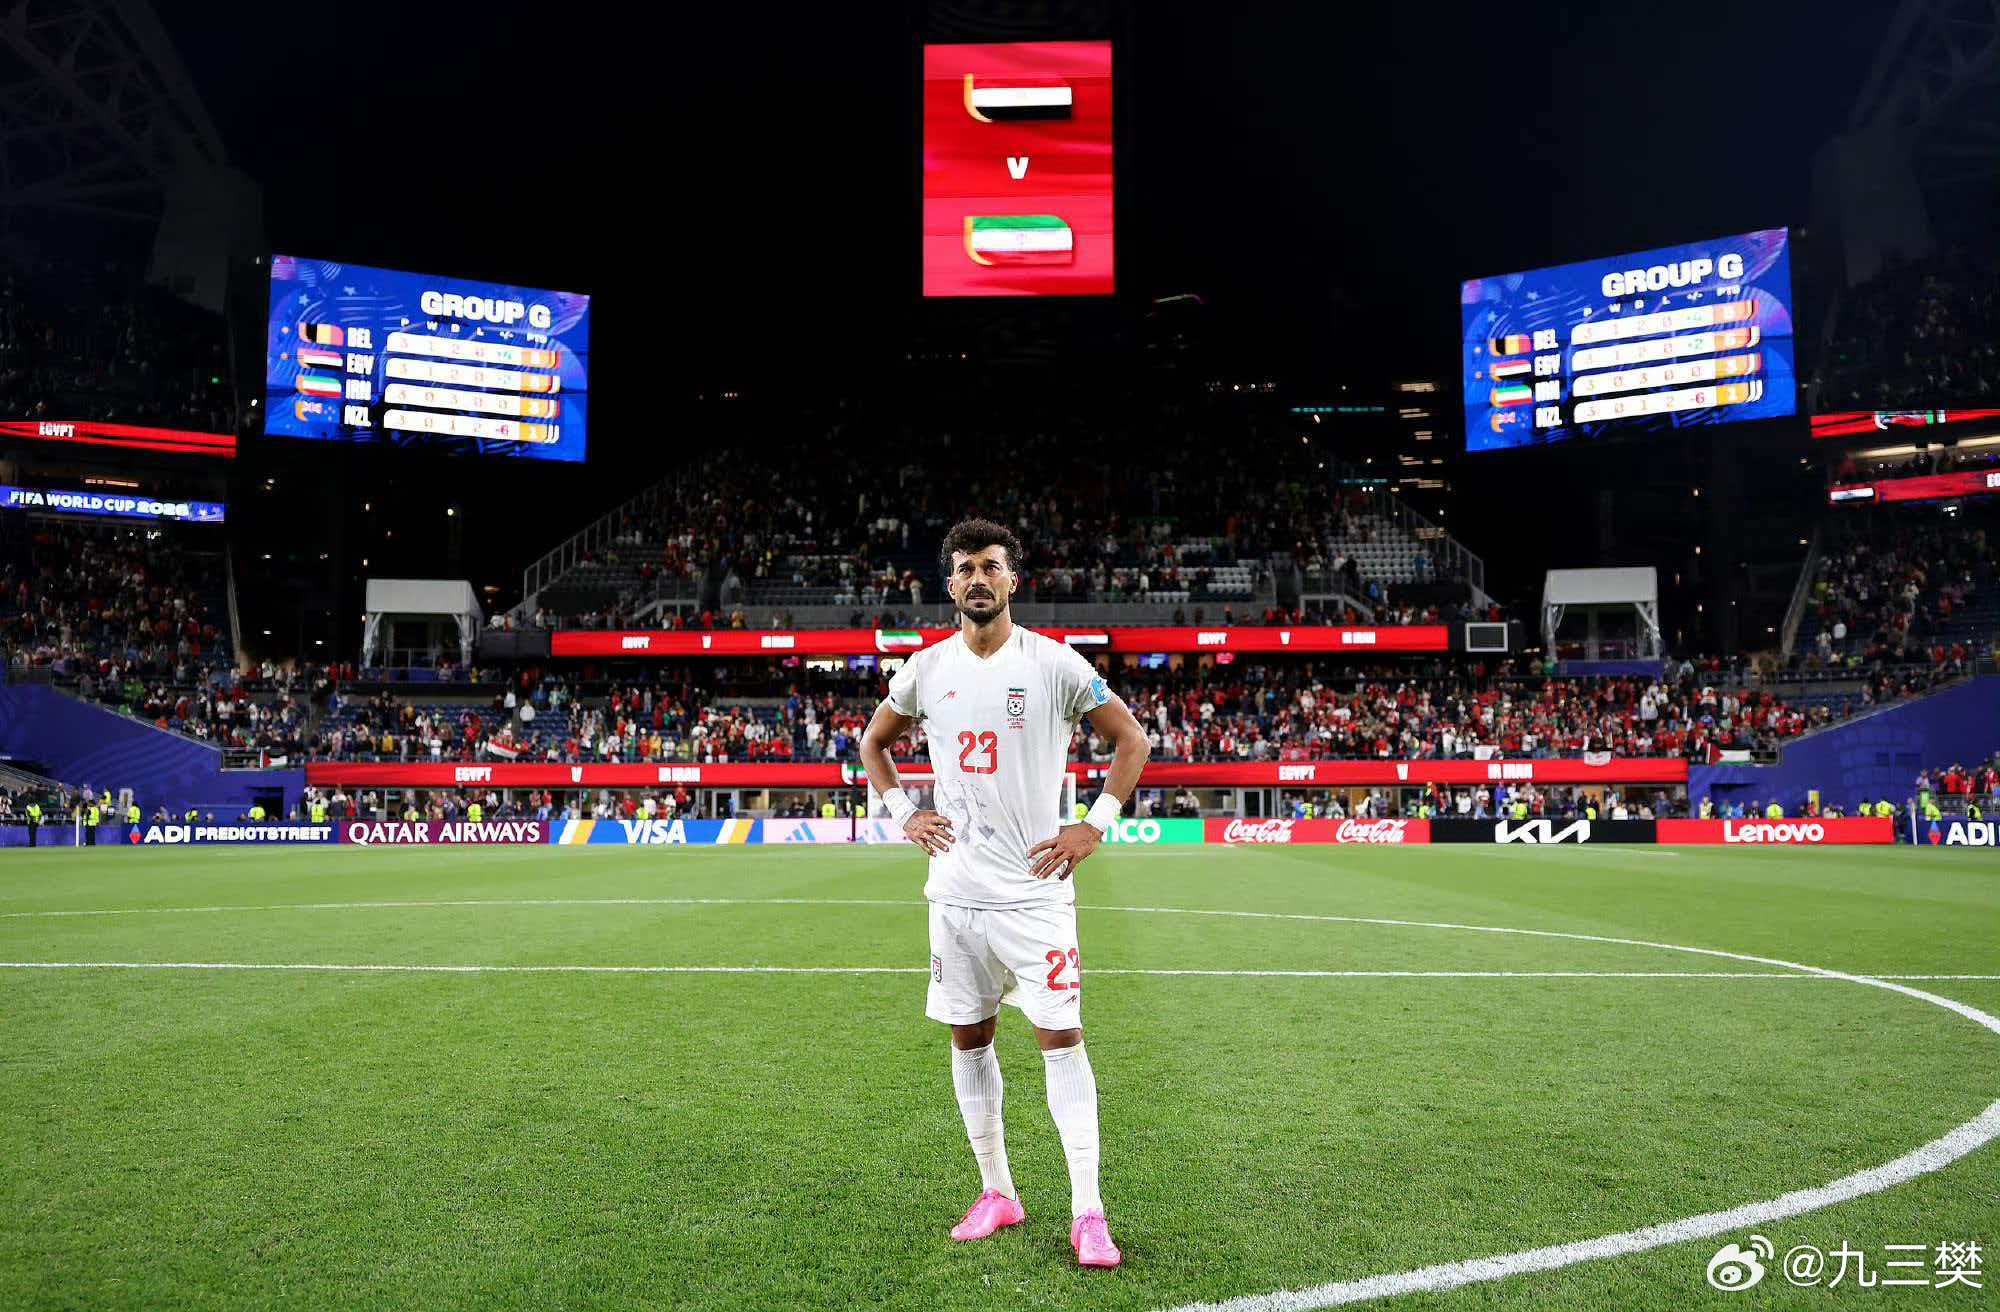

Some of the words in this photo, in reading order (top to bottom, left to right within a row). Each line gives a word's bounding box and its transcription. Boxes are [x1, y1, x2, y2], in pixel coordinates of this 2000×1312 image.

[1602, 259, 1713, 297] GROUP
[1718, 253, 1743, 279] G
[421, 291, 524, 323] GROUP
[529, 304, 550, 328] G
[1608, 303, 1620, 313] W
[426, 320, 438, 331] W
[39, 422, 75, 438] EGYPT
[9, 491, 43, 505] FIFA
[47, 493, 102, 510] WORLD
[102, 498, 136, 512] CUP
[137, 501, 190, 517] 2026
[958, 731, 998, 774] 23
[455, 767, 492, 782] EGYPT
[571, 767, 582, 782] V
[1279, 765, 1315, 780] EGYPT
[1397, 764, 1408, 780] V
[144, 825, 190, 843] ADI
[195, 826, 332, 841] PREDICTSTREET
[349, 822, 429, 846] QATAR
[439, 822, 540, 843] AIRWAYS
[618, 820, 687, 844] VISA
[1724, 820, 1824, 843] Lenovo
[1946, 821, 1995, 846] ADI
